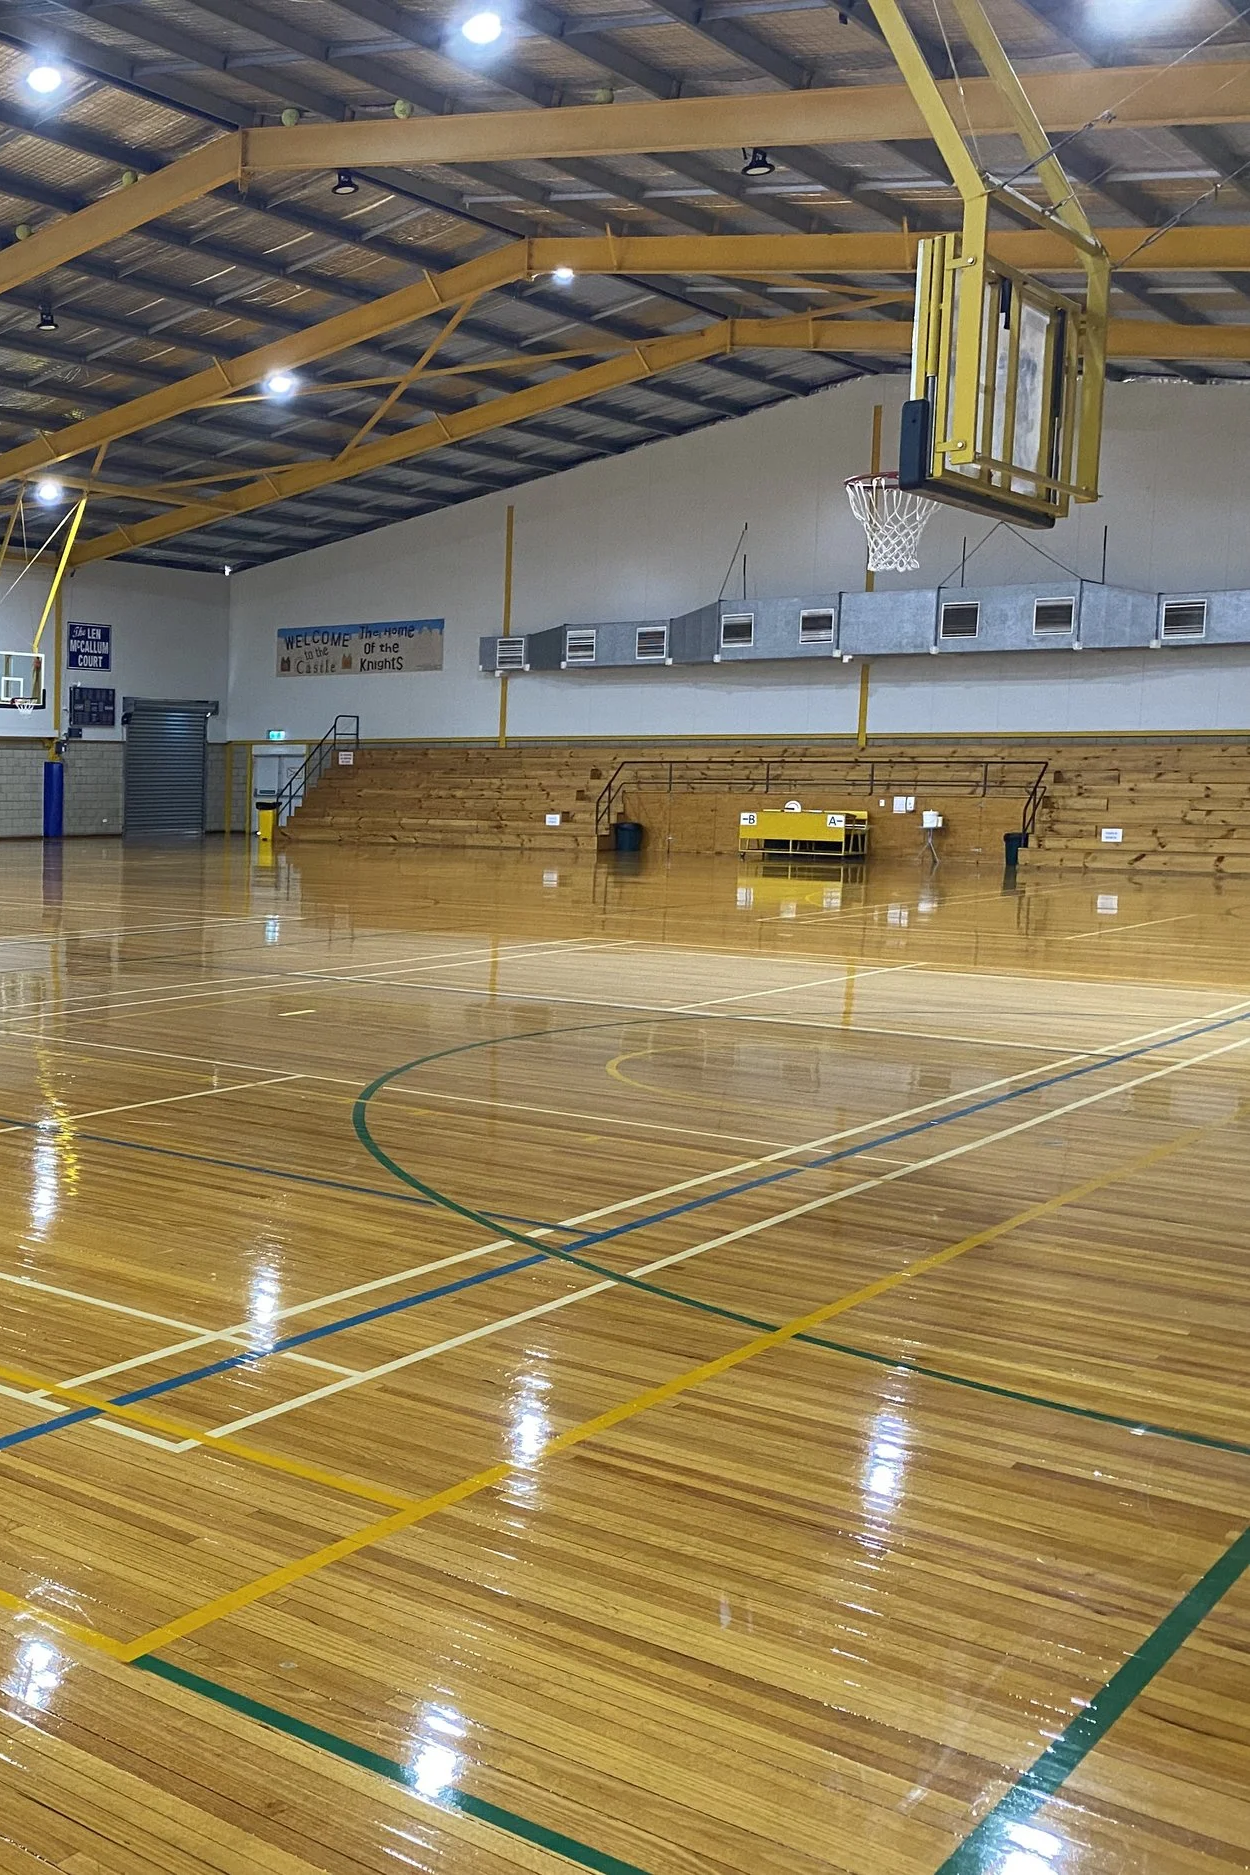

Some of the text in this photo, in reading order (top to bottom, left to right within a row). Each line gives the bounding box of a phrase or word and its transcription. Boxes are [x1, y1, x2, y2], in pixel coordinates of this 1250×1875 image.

[71, 627, 102, 640] The LEN
[384, 624, 416, 639] Home
[284, 629, 351, 651] WELCOME
[315, 646, 329, 659] the
[364, 642, 400, 655] Of the
[77, 654, 104, 668] COURT
[296, 660, 336, 675] Castle
